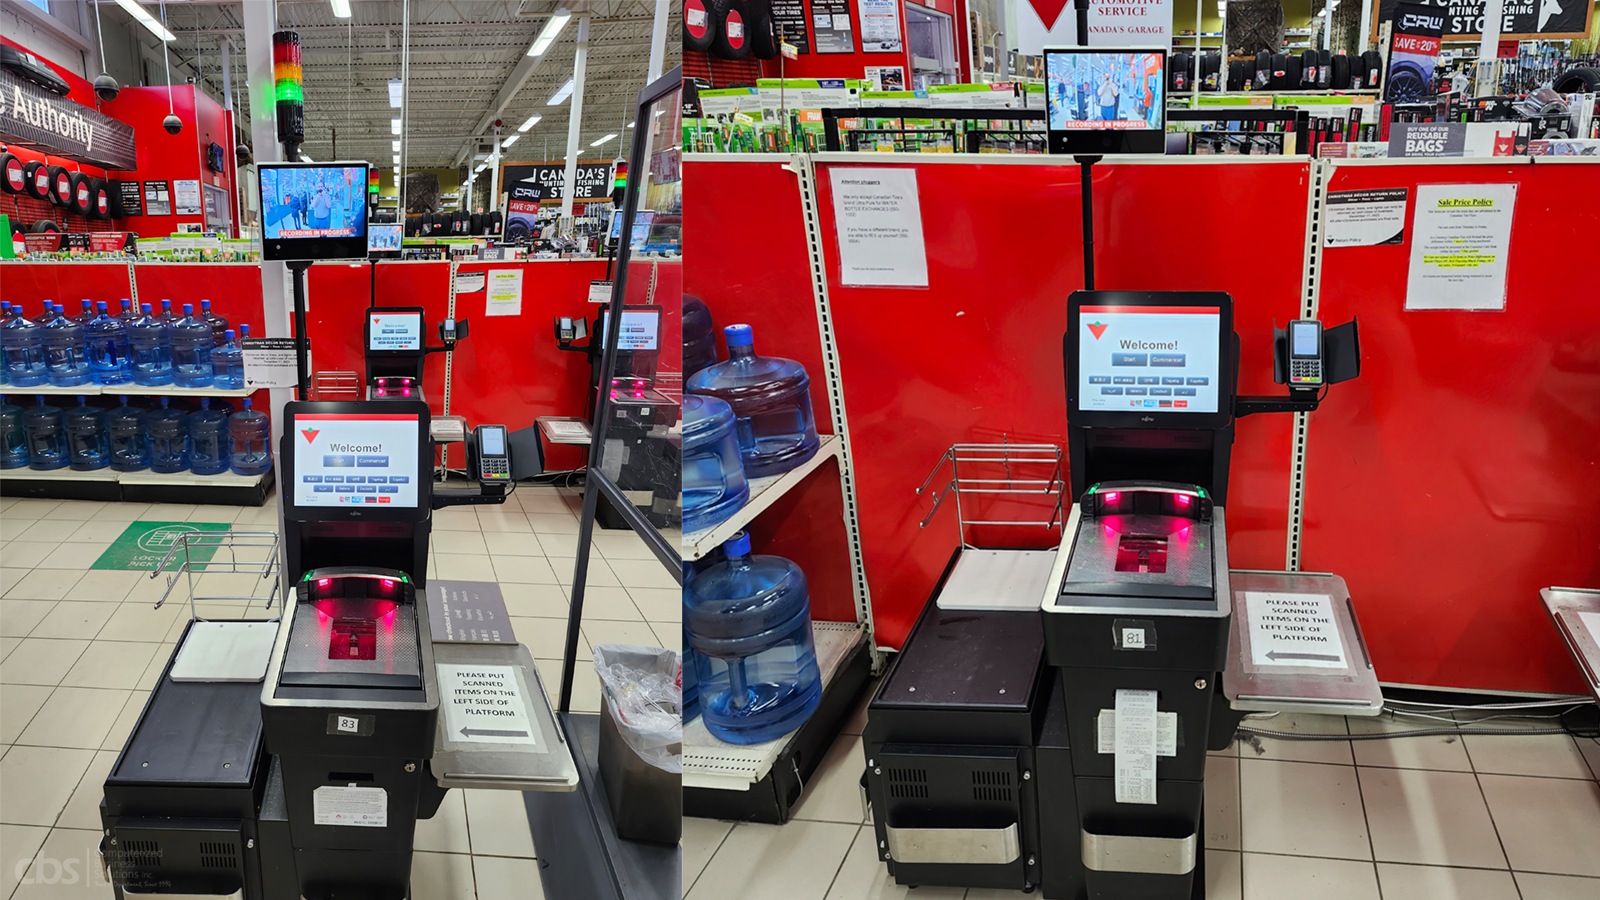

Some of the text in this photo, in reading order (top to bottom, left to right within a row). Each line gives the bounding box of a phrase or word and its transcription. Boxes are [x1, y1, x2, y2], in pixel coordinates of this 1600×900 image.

[1098, 7, 1147, 16] SERVICE
[1448, 5, 1533, 16] NTING SHING
[1401, 14, 1444, 30] CRW
[1451, 16, 1514, 32] STOE
[1394, 37, 1437, 52] SAVE 20%
[13, 85, 93, 151] Authority
[807, 112, 822, 120] FRAM
[540, 168, 605, 181] CANDA'S
[550, 186, 592, 198] STRE
[1120, 340, 1178, 350] Welcome!
[330, 444, 382, 452] Welcome!
[444, 616, 453, 634] checkout
[1126, 632, 1142, 644] 81
[1273, 634, 1327, 642] PLATFORM
[465, 708, 515, 717] PLATFORM
[341, 719, 355, 729] 83
